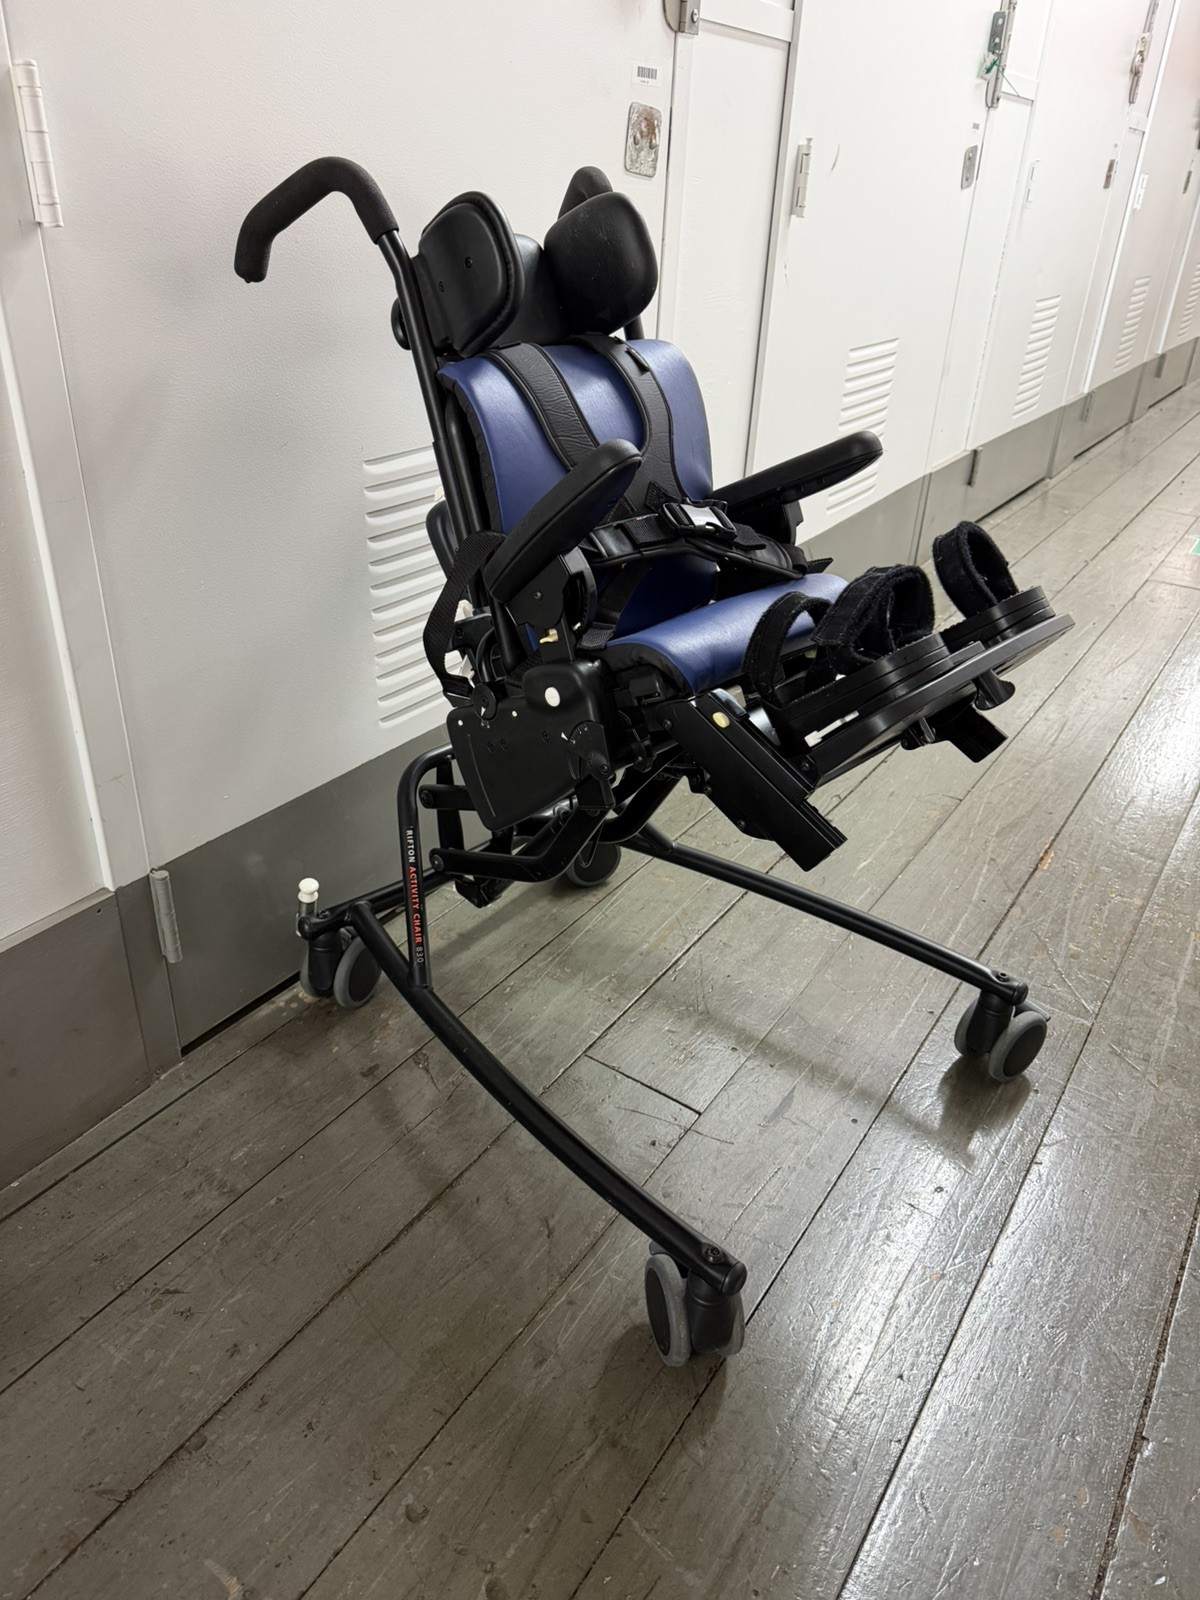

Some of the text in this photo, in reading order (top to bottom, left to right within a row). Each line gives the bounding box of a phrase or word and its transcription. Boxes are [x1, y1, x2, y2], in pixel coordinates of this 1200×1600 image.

[406, 829, 425, 963] RIFTON ACTIVITY CHAIR 830
